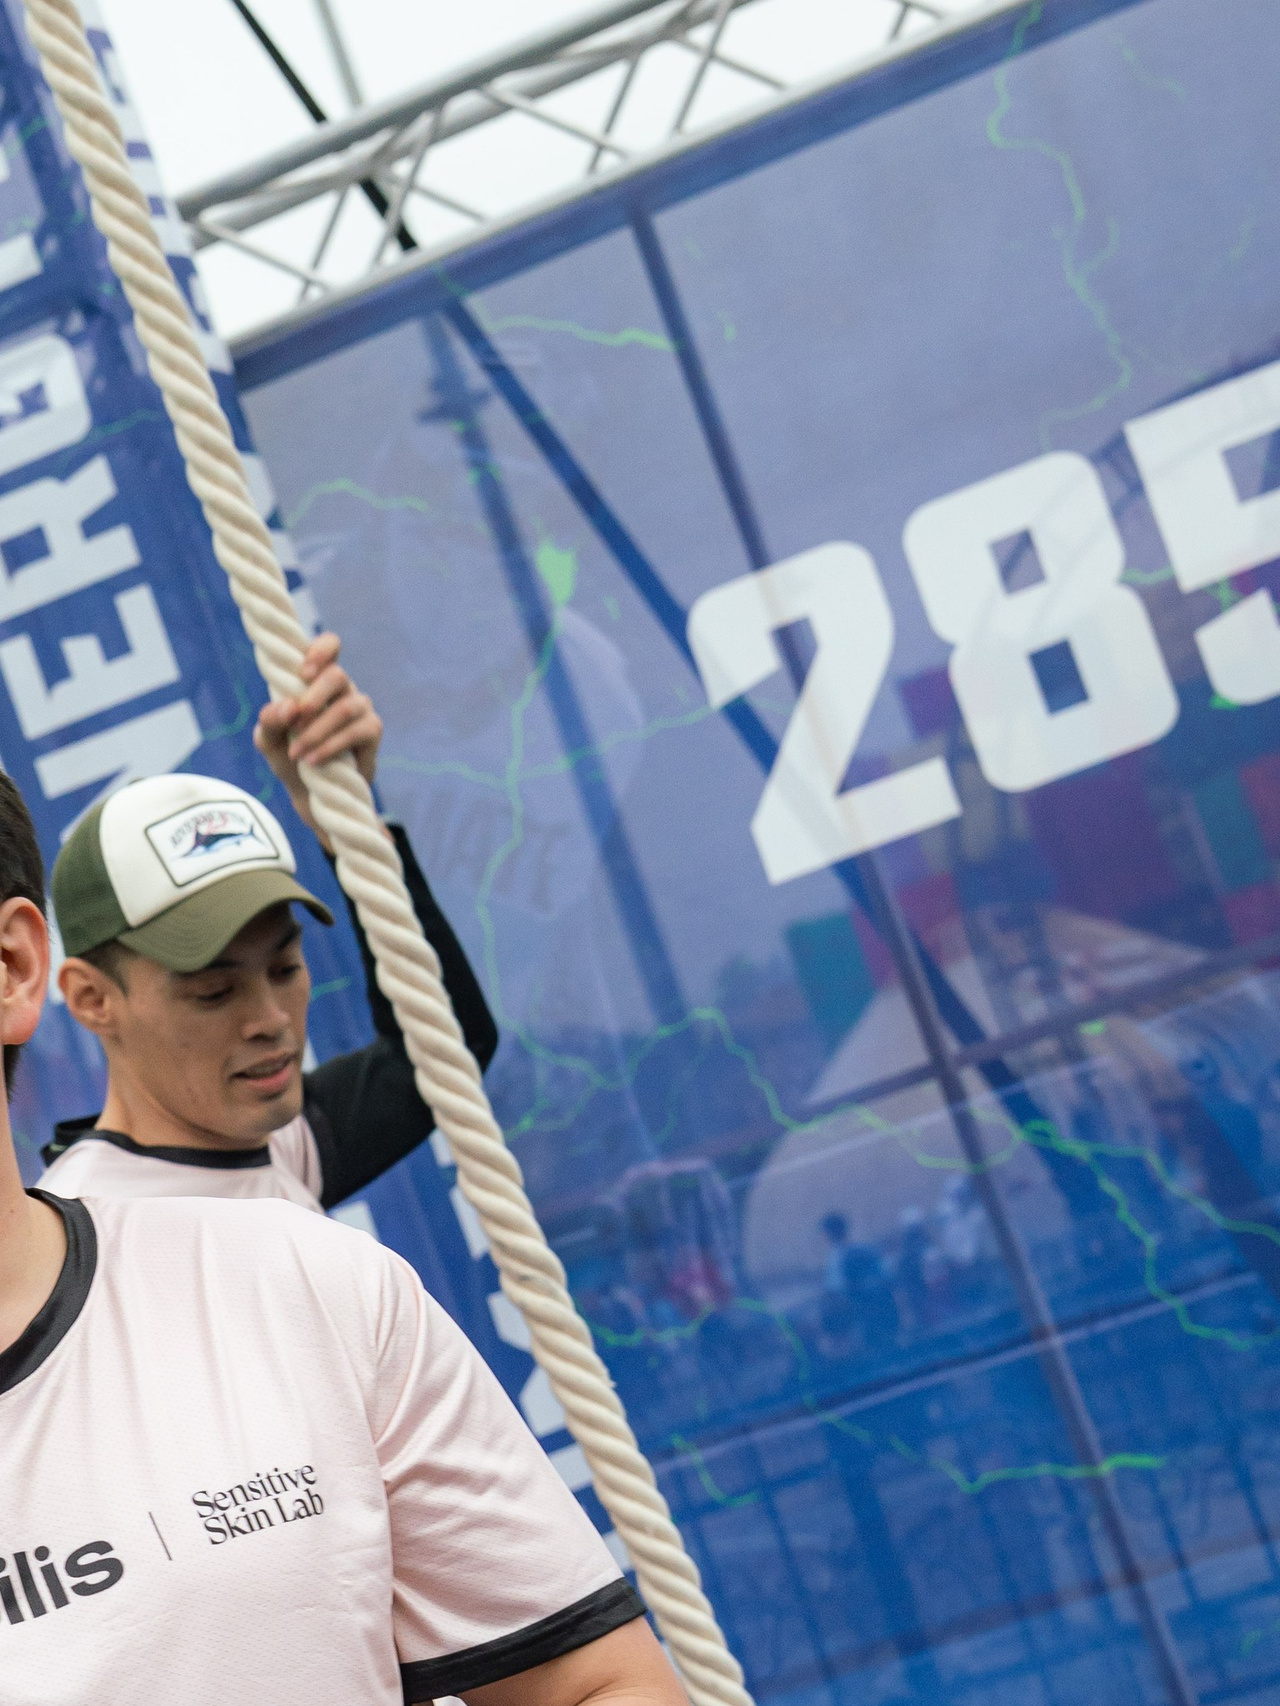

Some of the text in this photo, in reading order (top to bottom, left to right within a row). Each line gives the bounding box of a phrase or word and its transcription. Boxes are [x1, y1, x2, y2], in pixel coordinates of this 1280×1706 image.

[191, 1464, 317, 1519] Sensitive
[203, 1487, 325, 1546] Skin Lab
